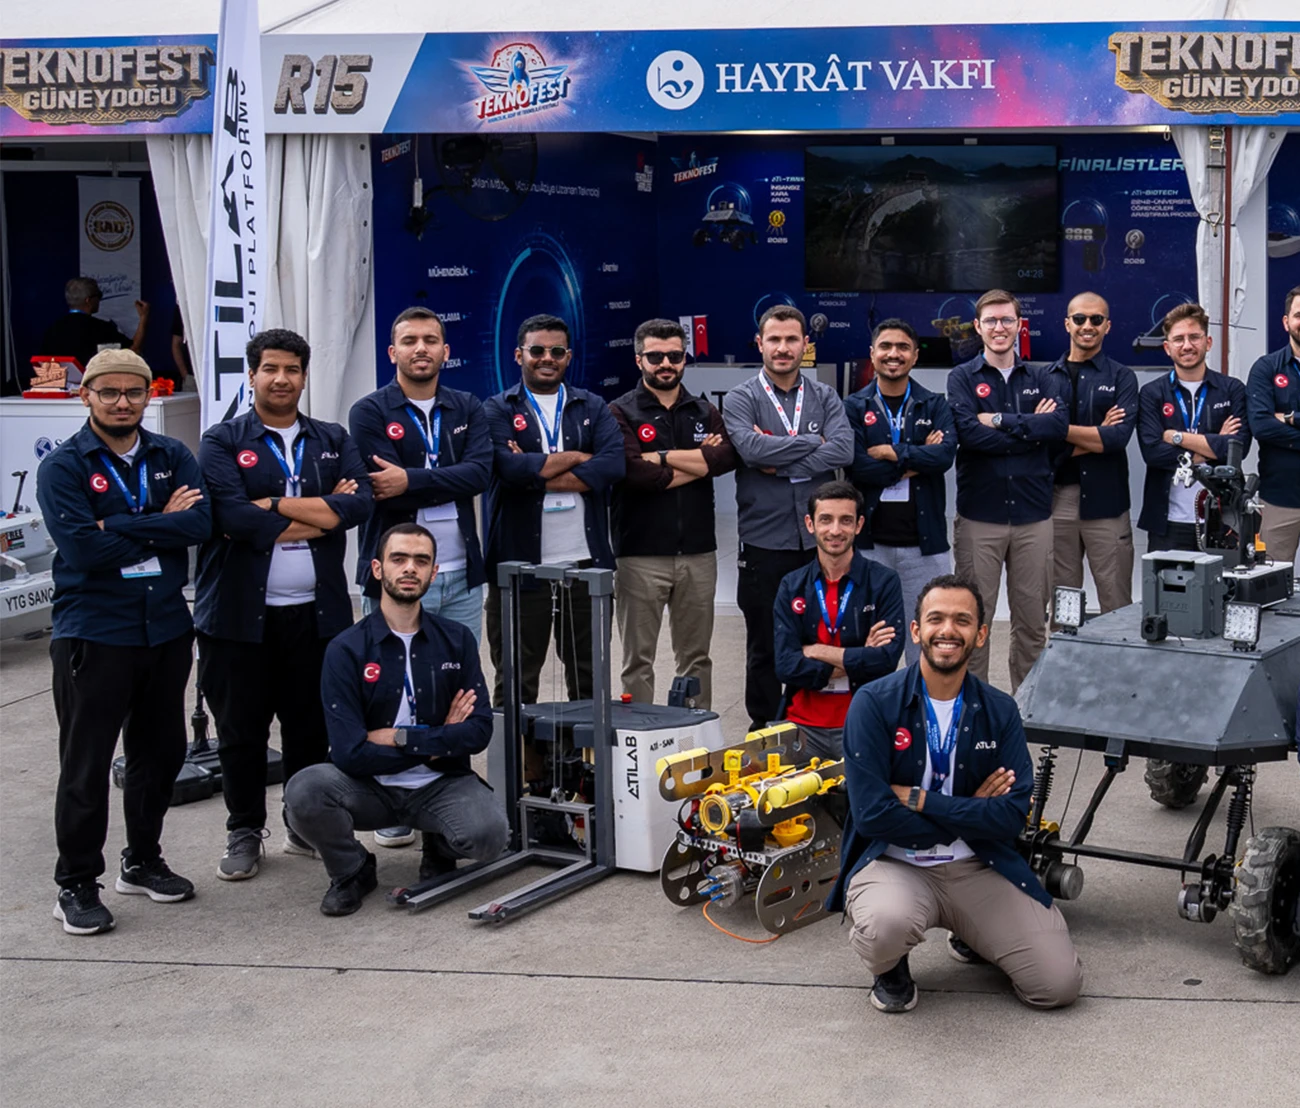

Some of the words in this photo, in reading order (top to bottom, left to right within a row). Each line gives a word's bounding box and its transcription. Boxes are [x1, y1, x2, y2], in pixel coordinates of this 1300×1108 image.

[0, 46, 214, 87] EKNOFEST
[716, 54, 872, 93] HAYRÂT
[880, 59, 995, 90] VAKFI
[23, 84, 178, 111] GÜNEYDOĞU
[274, 54, 372, 114] R15
[474, 76, 570, 119] TEKNOFEST
[673, 163, 718, 183] TEKNOFEST
[1018, 269, 1044, 279] 04:28
[5, 594, 26, 611] YTG
